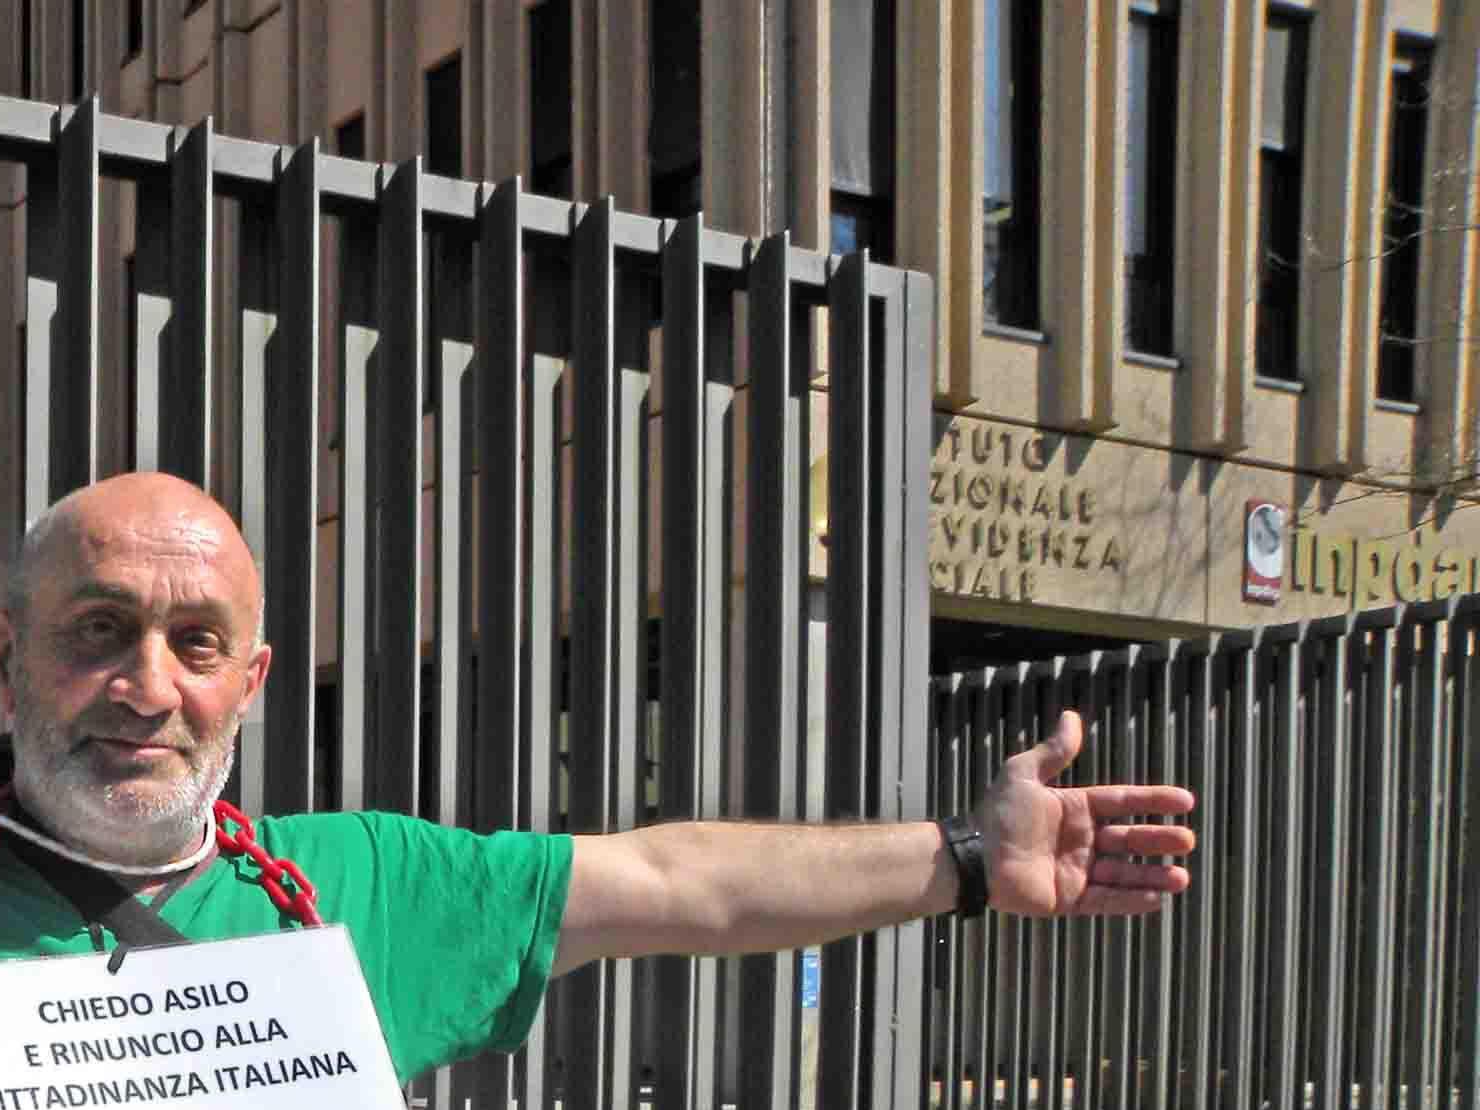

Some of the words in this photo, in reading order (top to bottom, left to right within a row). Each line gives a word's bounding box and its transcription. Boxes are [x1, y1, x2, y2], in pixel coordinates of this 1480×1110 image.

[929, 471, 1096, 524] ZIONALE
[941, 516, 1120, 572] VIDENZA
[929, 560, 1038, 600] CIALE
[38, 992, 154, 1024] CHIEDO
[164, 980, 248, 1013] ASILO
[23, 1044, 42, 1067] E
[49, 1028, 204, 1065] RINUNCIO
[215, 1017, 288, 1048] ALLA
[213, 1050, 357, 1092] ITALIANA
